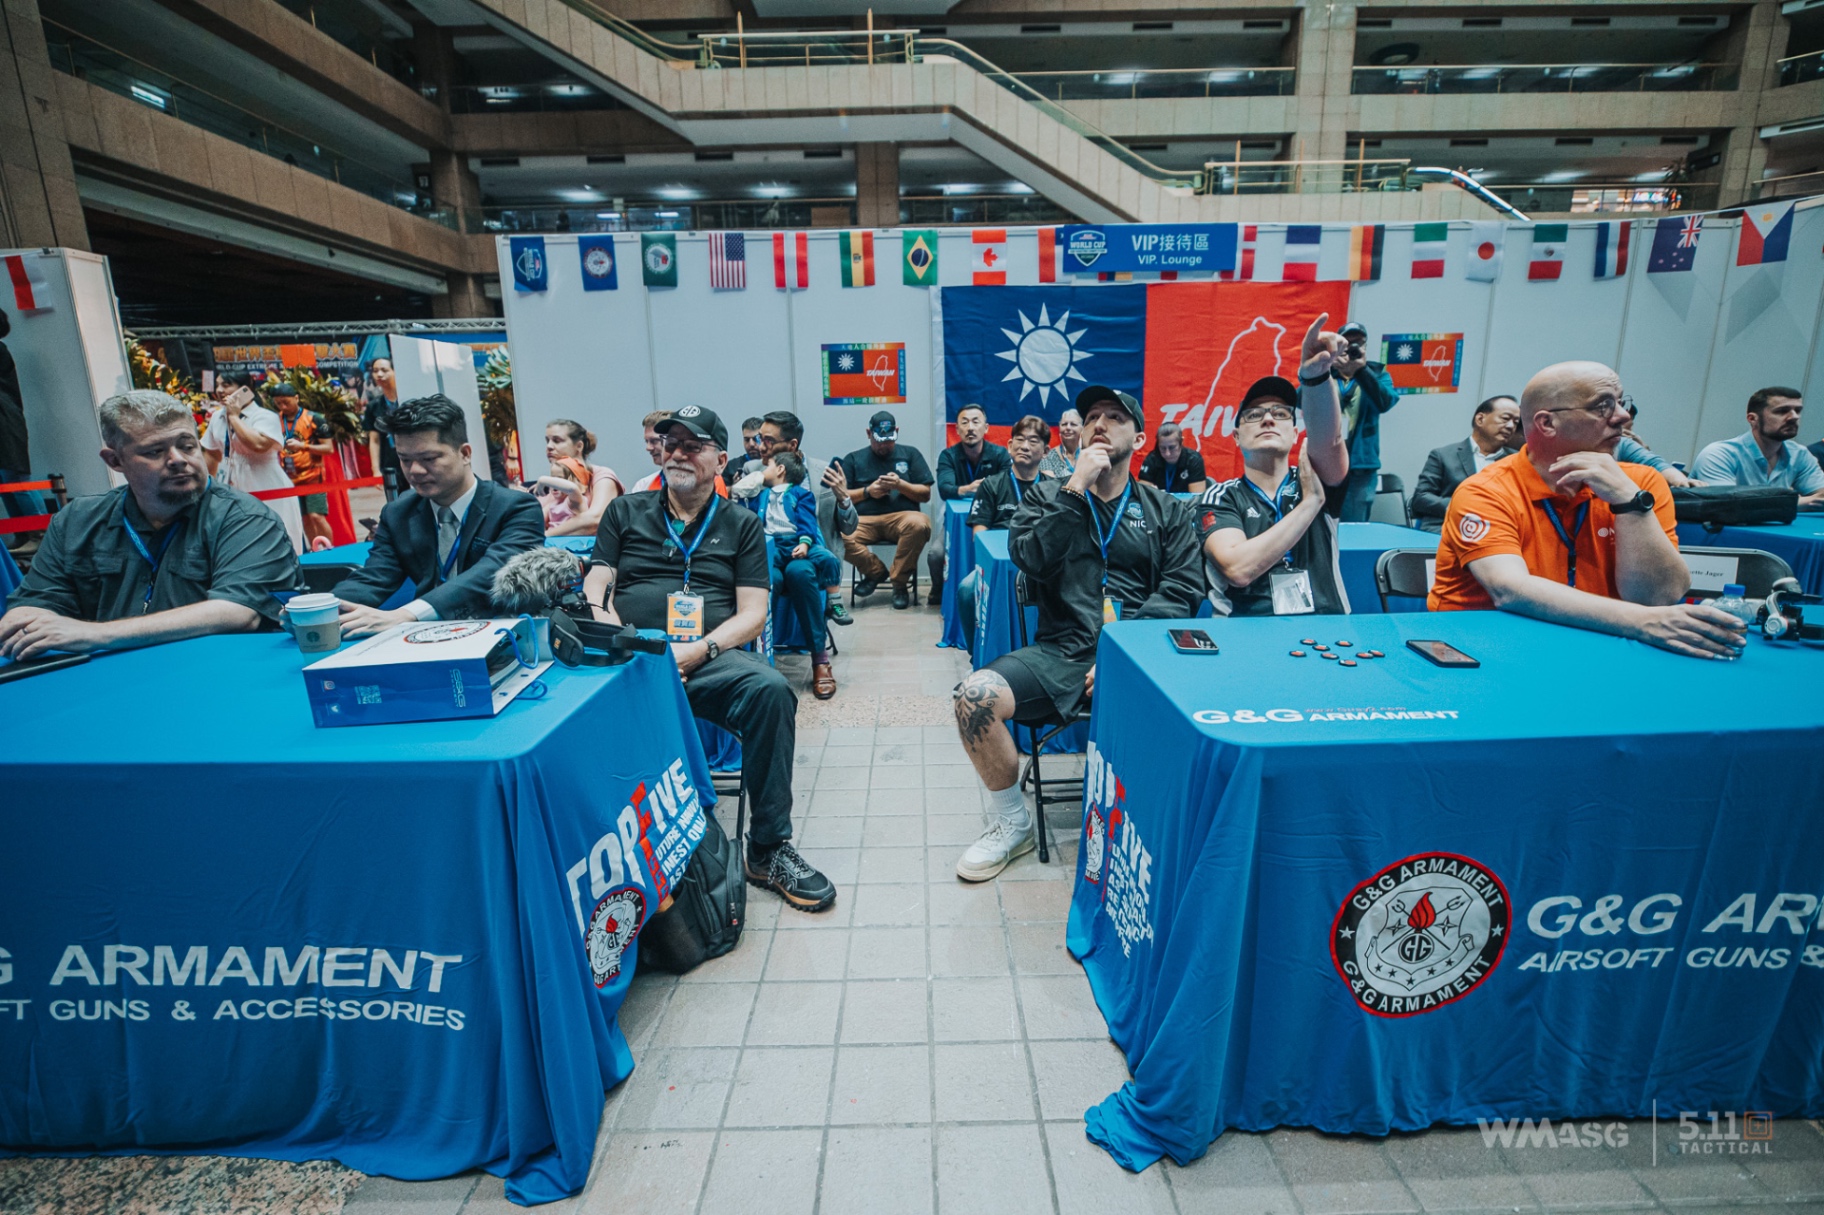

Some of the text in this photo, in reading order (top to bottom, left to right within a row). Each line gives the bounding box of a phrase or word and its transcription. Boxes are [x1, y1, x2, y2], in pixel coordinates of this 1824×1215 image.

[1131, 233, 1210, 251] VIP接待區
[1138, 254, 1203, 266] VIP. Lounge
[1192, 708, 1459, 724] G&G ARMAMENT
[1352, 858, 1504, 910] G&G ARMAMENT
[1527, 893, 1683, 939] G&G
[49, 944, 463, 993] ARMAMENT
[1518, 947, 1674, 973] AIRSOFT
[1685, 946, 1791, 969] GUNS
[1342, 955, 1491, 1012] G&G ARMAMENT
[49, 998, 150, 1021] GUNS
[171, 999, 197, 1021] &
[213, 997, 466, 1031] ACCESSORIES
